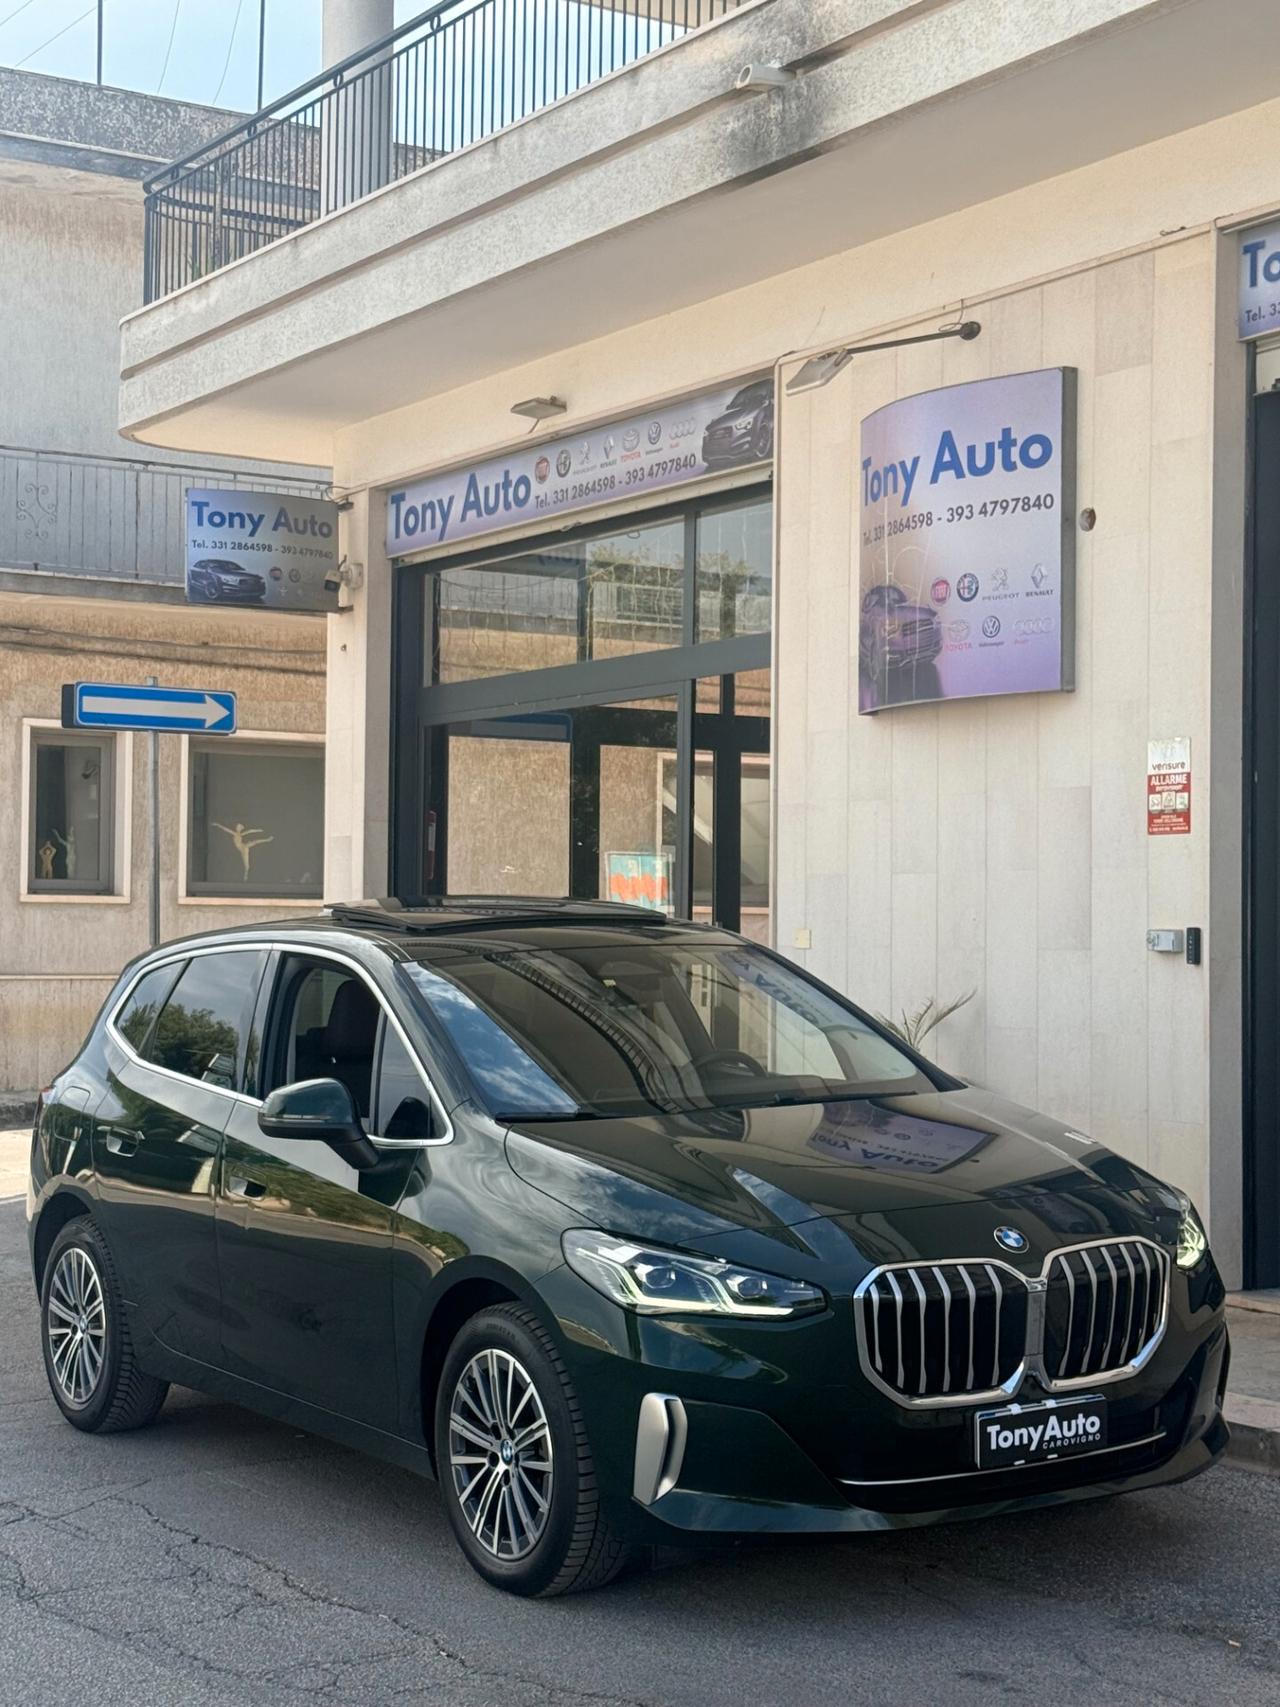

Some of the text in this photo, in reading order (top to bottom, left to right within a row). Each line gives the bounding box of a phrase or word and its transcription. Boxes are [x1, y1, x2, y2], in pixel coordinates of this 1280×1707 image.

[1245, 306, 1266, 322] Tel.
[534, 493, 550, 509] Tel.
[552, 488, 570, 505] 331
[571, 475, 617, 501] 2864598
[624, 466, 646, 486] 393
[647, 453, 697, 479] 4797840
[862, 426, 1053, 507] Tony Auto
[191, 500, 334, 539] Tony Auto
[390, 468, 532, 542] Tony Auto
[887, 511, 934, 537] 2864598
[946, 504, 975, 523] 393
[978, 493, 1055, 518] 4797840
[191, 539, 209, 550] Tel.
[211, 540, 228, 550] 331
[230, 541, 274, 553] 2864598
[1150, 774, 1188, 786] ALLARME
[986, 1413, 1101, 1451] TonyAuto
[1042, 1433, 1101, 1449] CAROVIGNO
